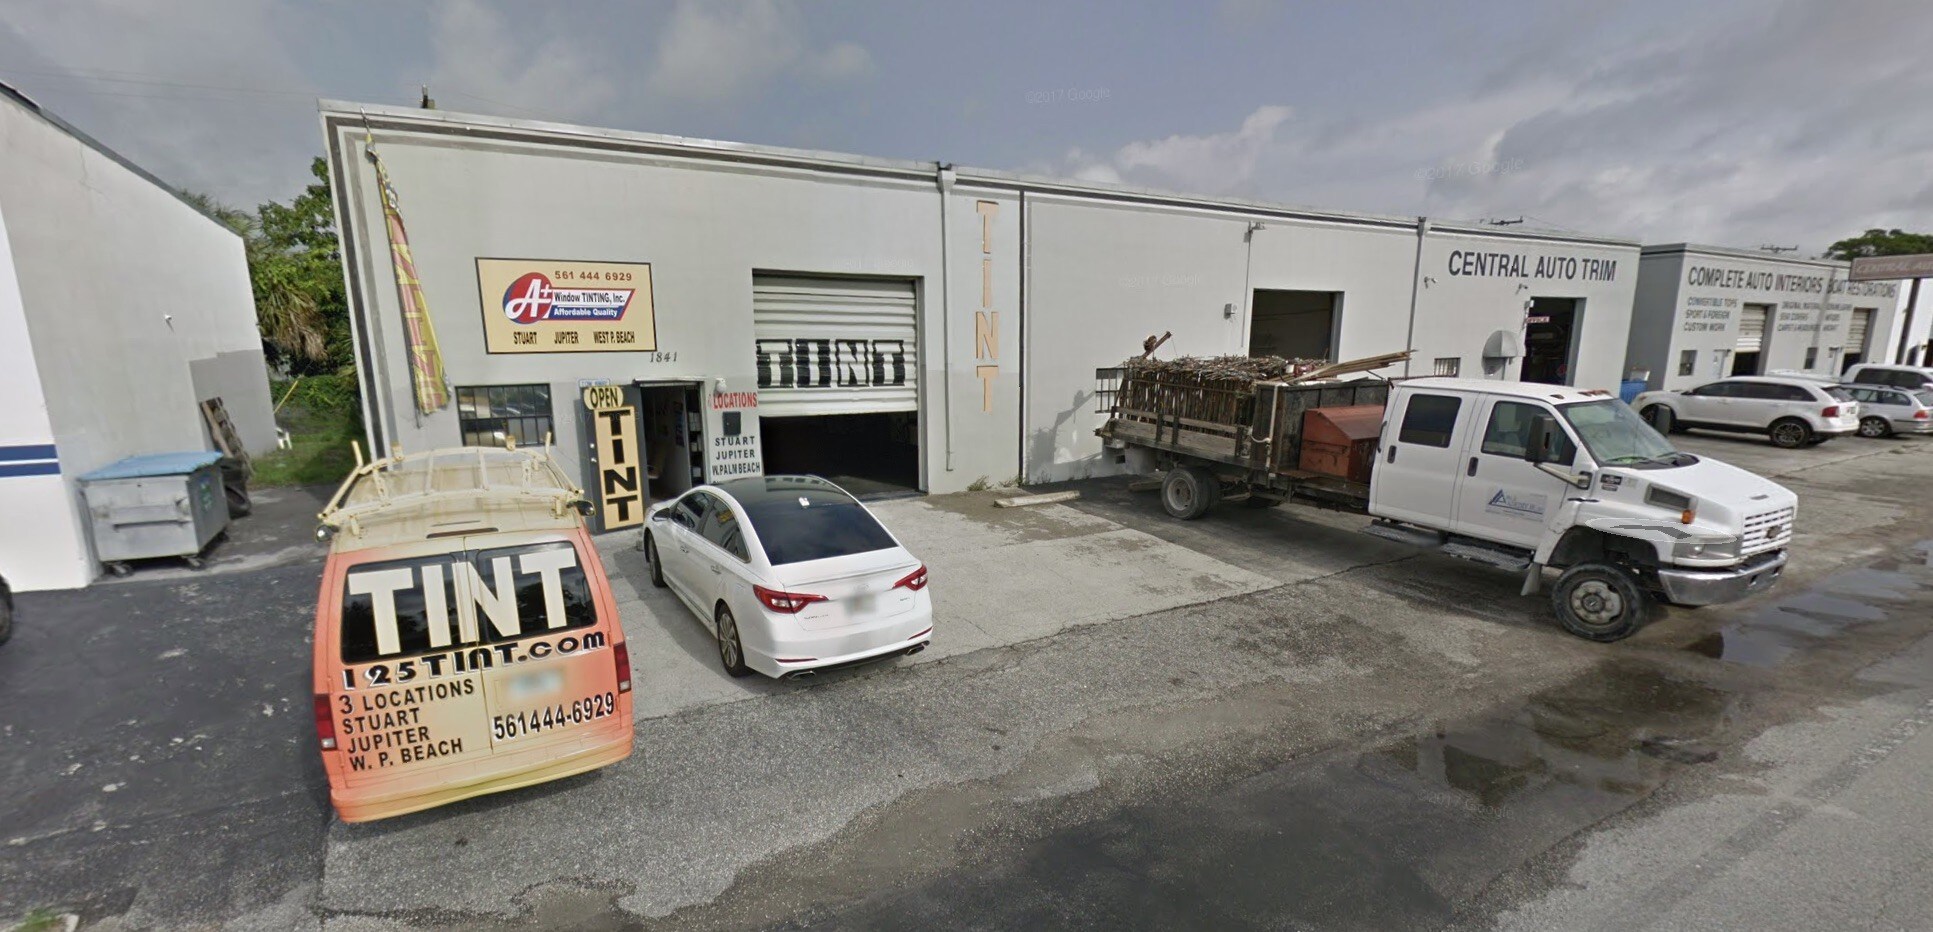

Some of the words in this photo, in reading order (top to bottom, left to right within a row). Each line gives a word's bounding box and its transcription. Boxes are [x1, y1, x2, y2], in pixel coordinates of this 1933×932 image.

[555, 271, 574, 280] 561
[580, 271, 600, 281] 444
[605, 272, 632, 281] 6929
[1448, 250, 1529, 278] CENTRAL
[1534, 256, 1577, 280] AUTO
[1581, 258, 1617, 282] TRIM
[1688, 266, 1745, 289] COMPLETE
[1745, 271, 1773, 291] AUTO
[1774, 273, 1823, 294] INTERIORS
[554, 292, 581, 303] Window
[581, 292, 612, 304] TINTING,
[613, 293, 625, 303] Inc.
[976, 200, 999, 415] TINT
[554, 307, 591, 316] Affordable
[593, 308, 618, 318] Quality
[513, 331, 537, 345] STUART
[554, 331, 579, 344] JUPITER
[593, 331, 610, 344] WEST
[610, 331, 616, 343] P.
[616, 331, 636, 343] BEACH
[650, 351, 678, 363] 1841
[756, 338, 906, 388] TINT
[590, 387, 619, 408] OPEN
[713, 391, 758, 409] LOCATIONS
[715, 436, 755, 447] STUART
[716, 449, 755, 461] JUPITER
[598, 409, 638, 522] TINT
[347, 547, 577, 656] TINT
[338, 694, 353, 715] 3
[363, 678, 475, 713] LOCATIONS
[343, 708, 420, 735] STUART
[347, 726, 430, 754] JUPITER
[350, 755, 372, 772] W.
[379, 752, 394, 768] P.
[401, 738, 463, 764] BEACH
